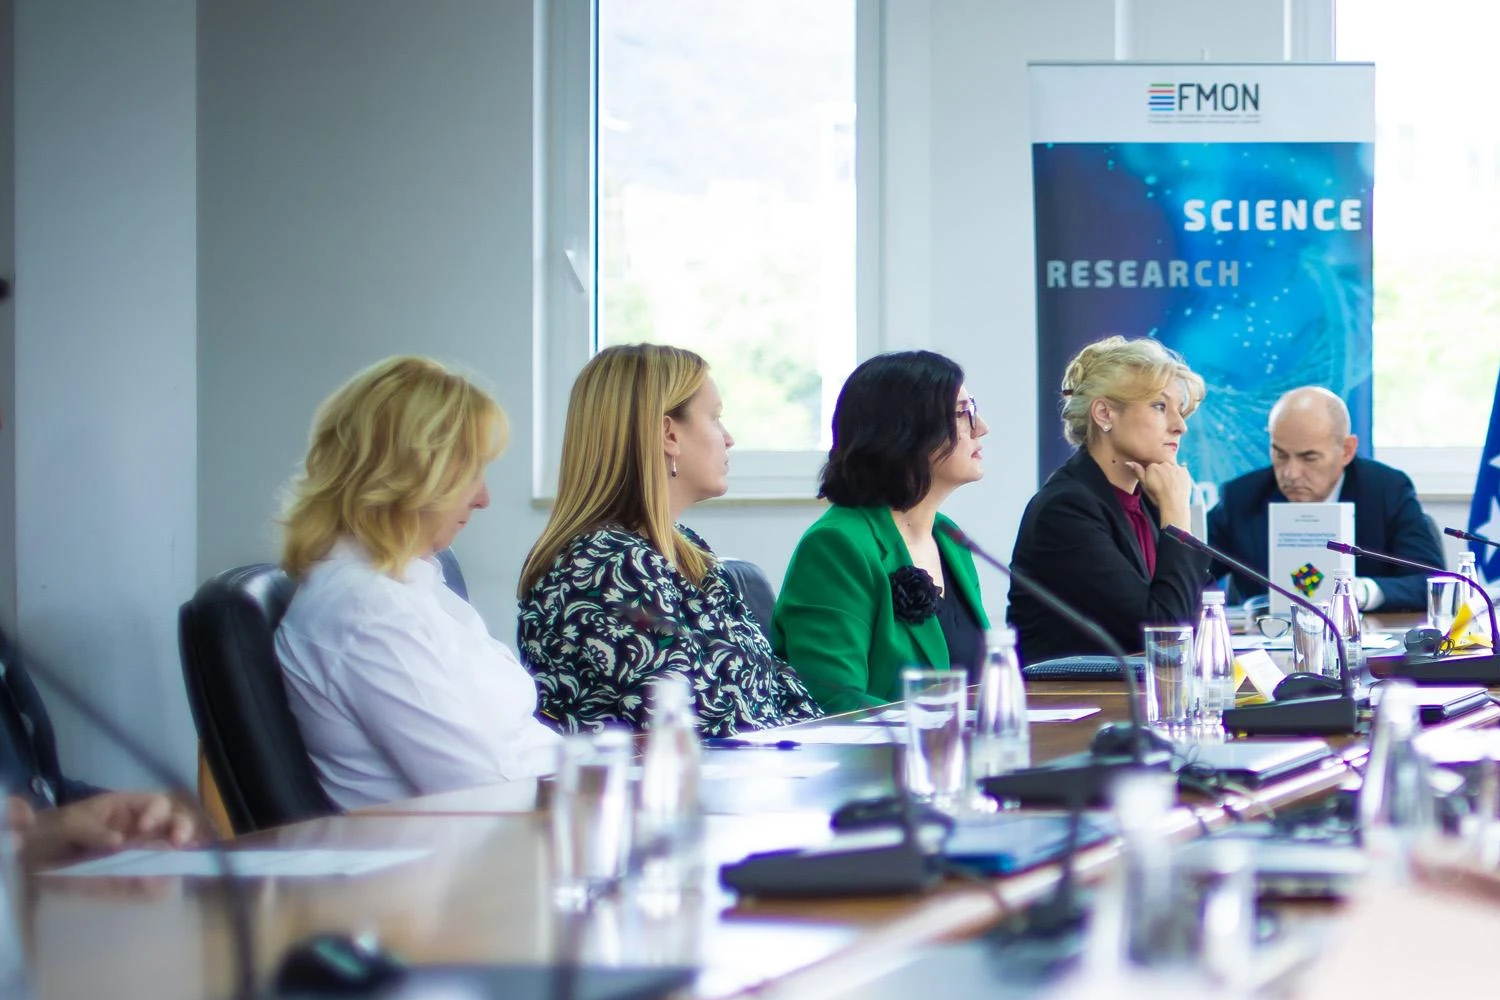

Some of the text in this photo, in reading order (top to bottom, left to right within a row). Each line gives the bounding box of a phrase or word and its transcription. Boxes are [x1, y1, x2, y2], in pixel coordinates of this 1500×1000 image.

[1178, 83, 1260, 112] FMON
[1184, 199, 1363, 231] SCIENCE
[1046, 260, 1240, 288] RESEARCH
